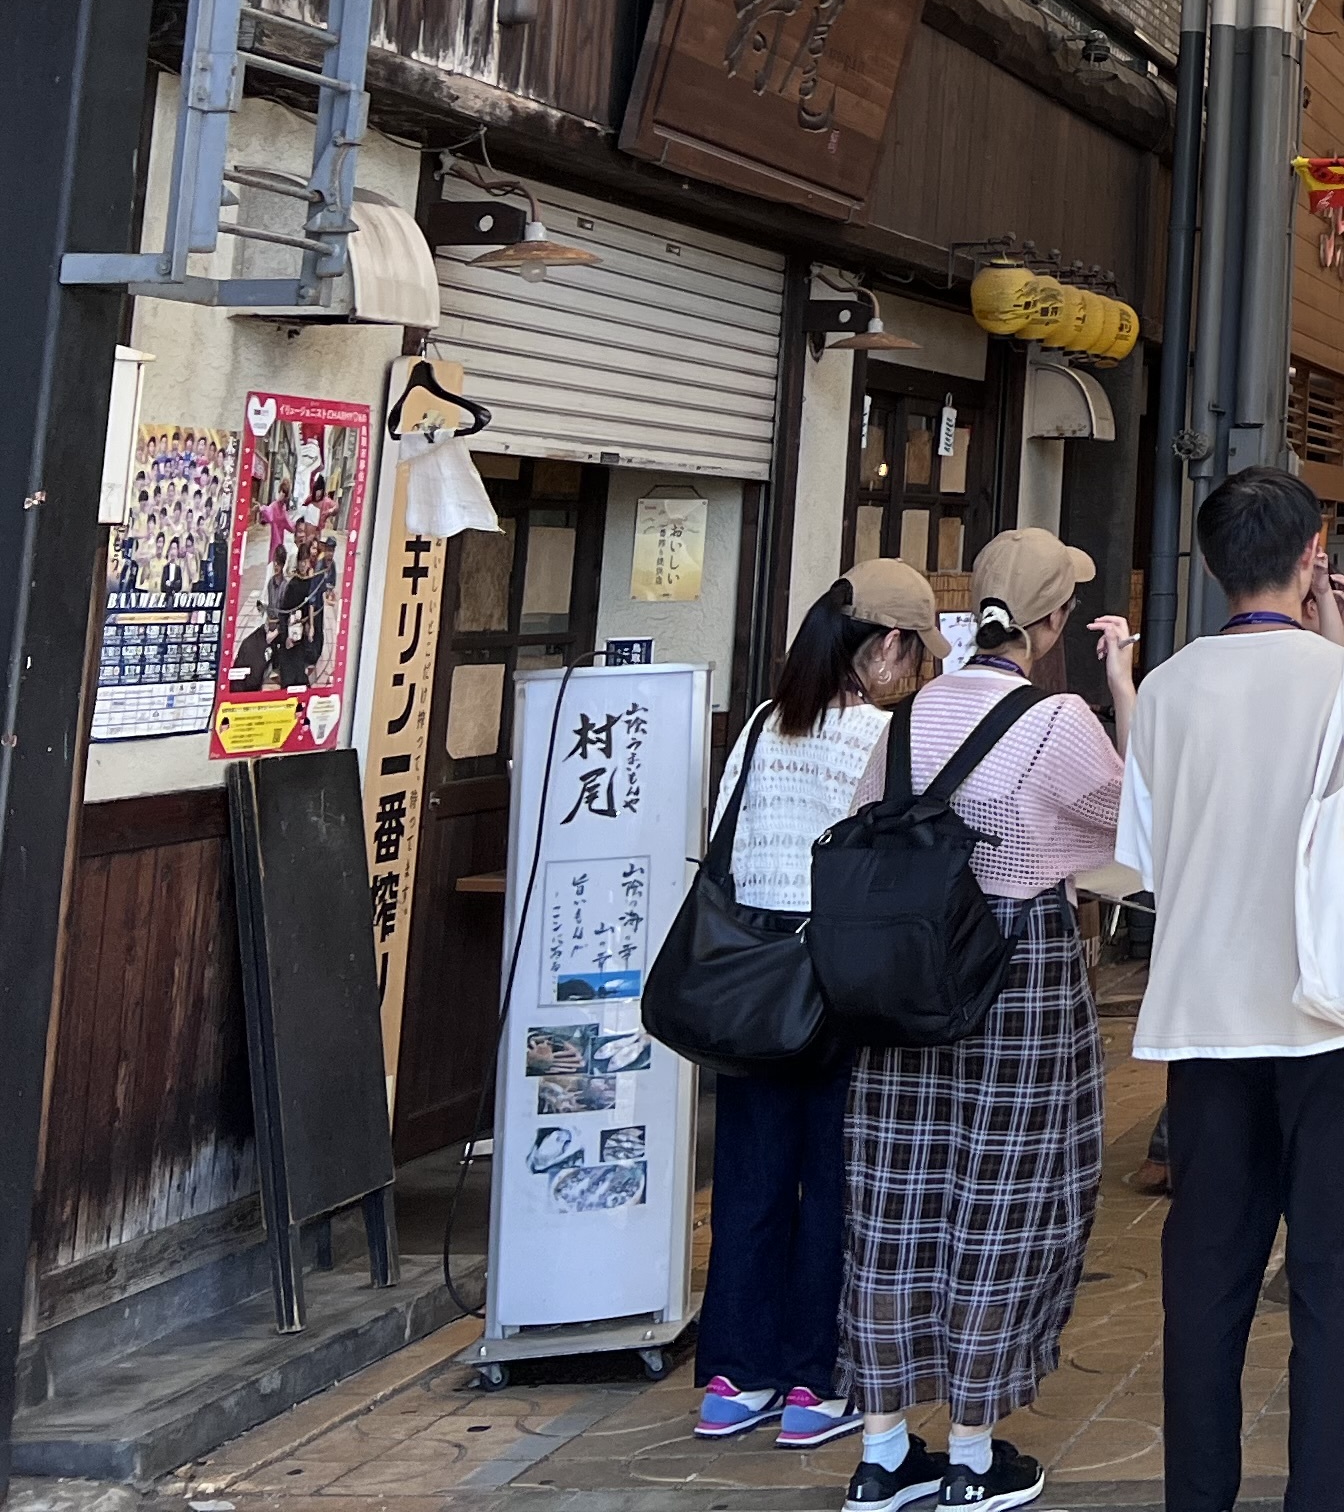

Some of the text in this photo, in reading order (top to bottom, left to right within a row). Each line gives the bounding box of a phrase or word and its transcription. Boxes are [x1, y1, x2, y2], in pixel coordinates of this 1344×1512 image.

[667, 523, 685, 585] おいしい
[560, 713, 624, 826] 村尾
